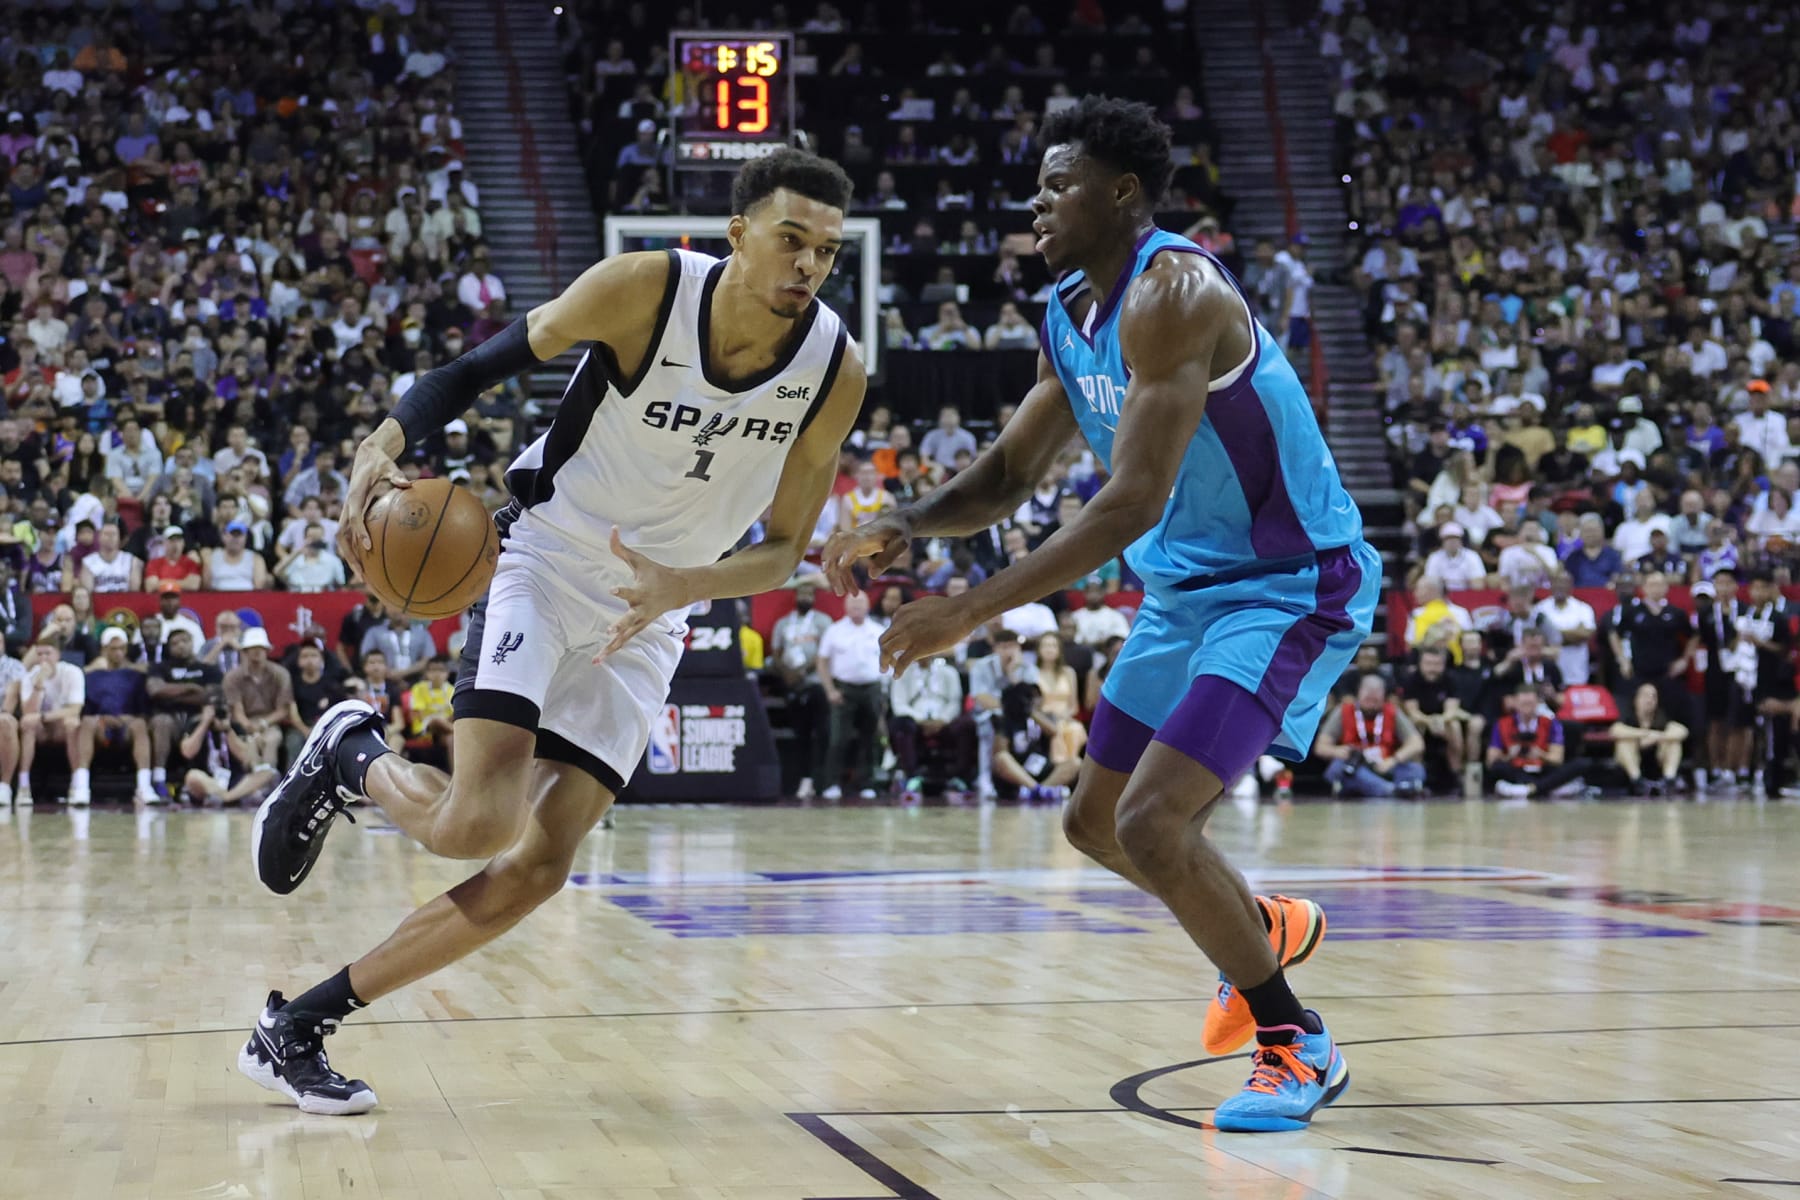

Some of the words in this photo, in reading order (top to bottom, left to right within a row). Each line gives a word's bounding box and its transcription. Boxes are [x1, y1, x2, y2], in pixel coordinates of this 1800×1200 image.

[717, 76, 769, 133] 13
[775, 385, 811, 401] Self.
[641, 400, 794, 447] SPURS
[684, 449, 716, 482] 1
